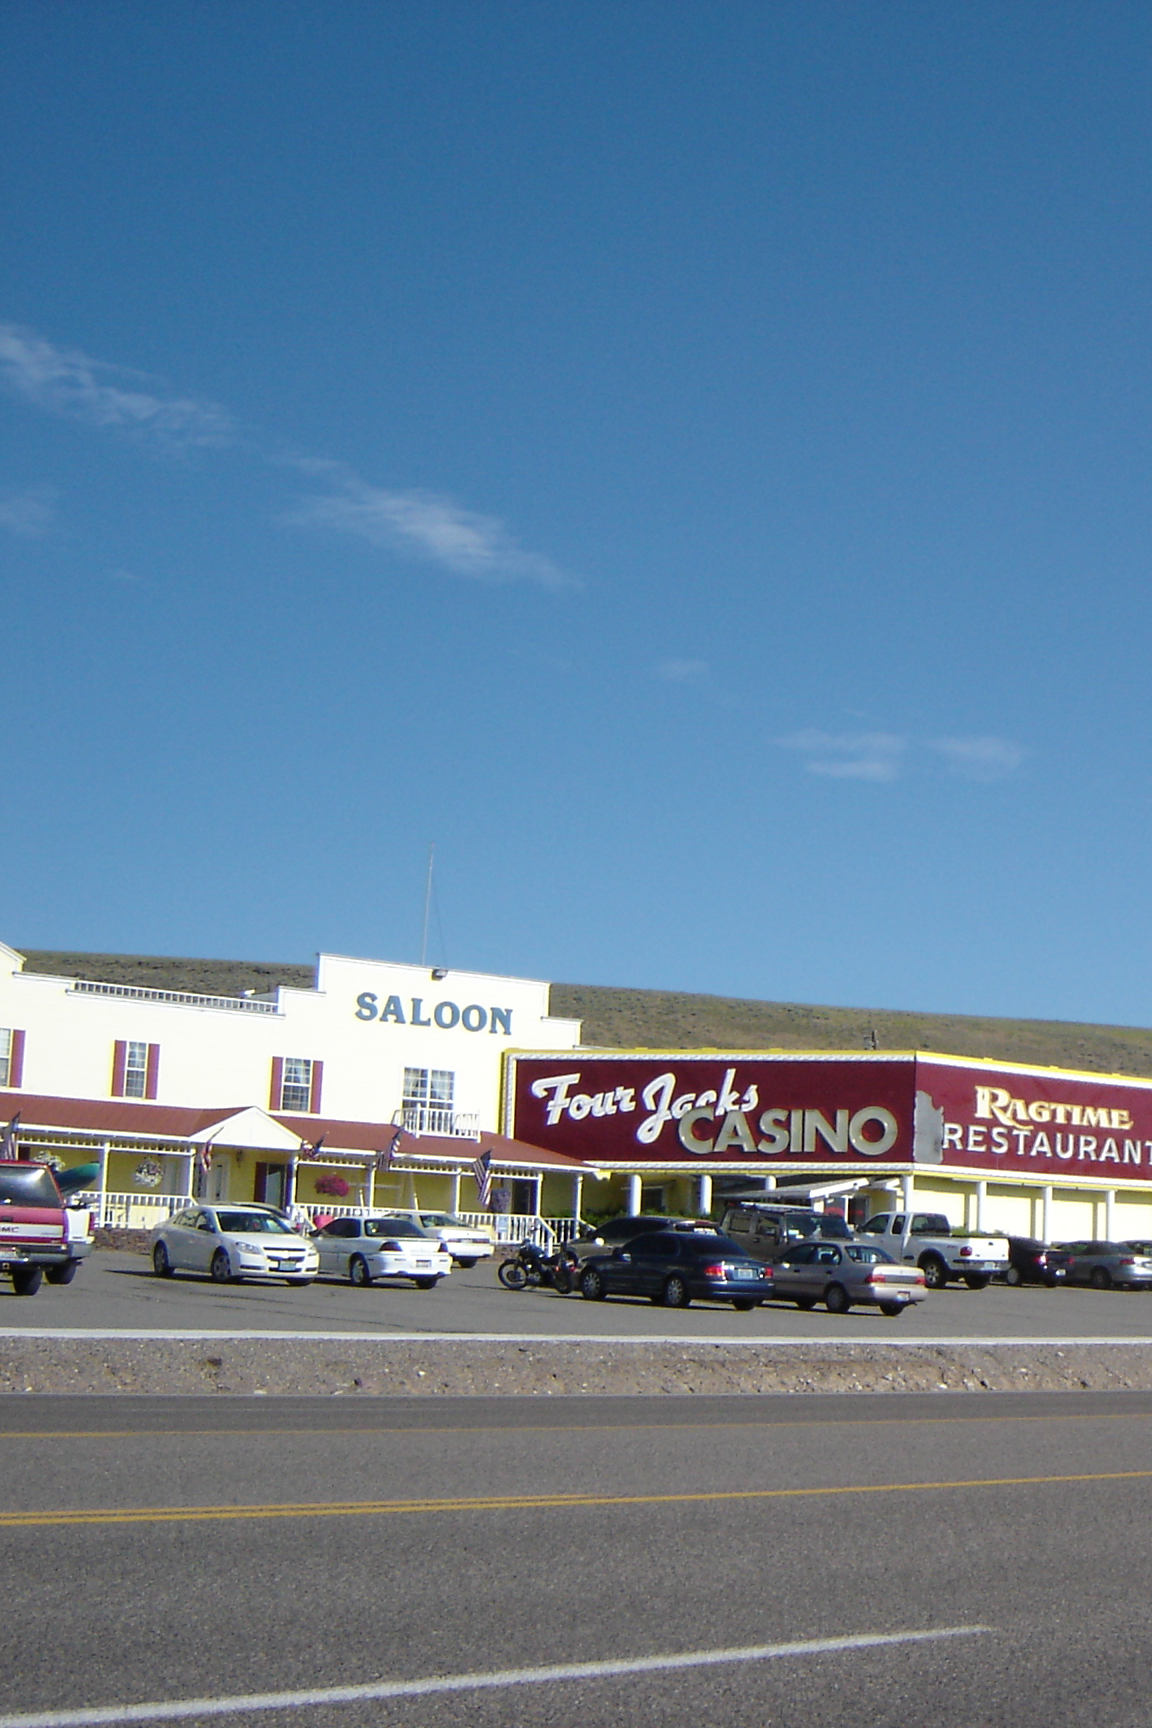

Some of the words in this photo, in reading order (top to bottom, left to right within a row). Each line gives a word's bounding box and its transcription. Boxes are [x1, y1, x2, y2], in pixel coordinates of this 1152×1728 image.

[355, 992, 513, 1035] SALOON
[531, 1073, 635, 1125] Four
[636, 1068, 757, 1144] Jacks
[678, 1106, 897, 1156] CASINO
